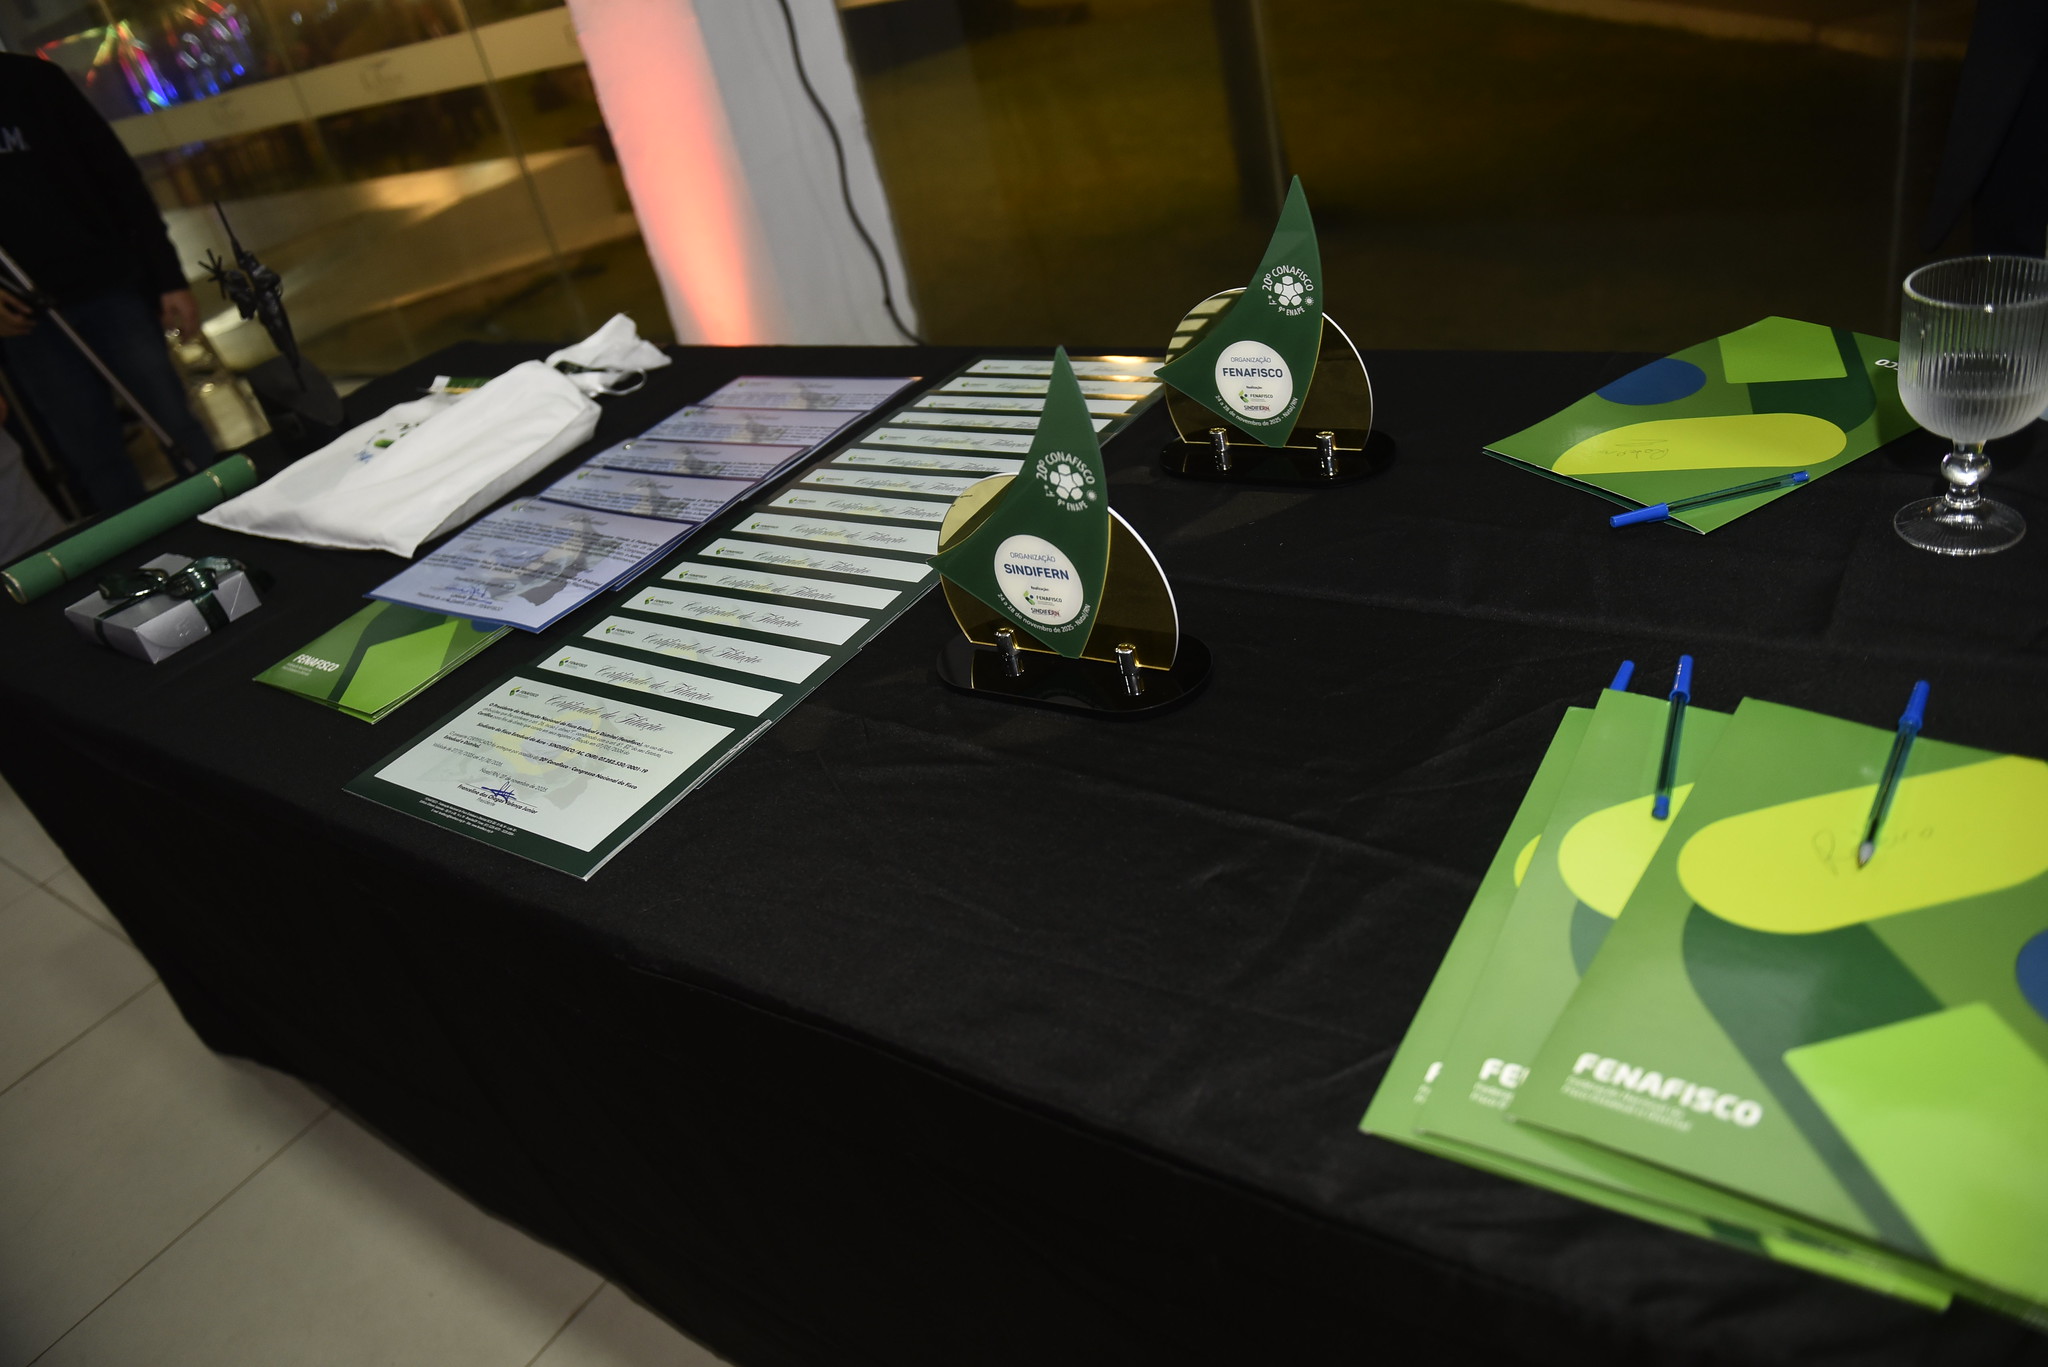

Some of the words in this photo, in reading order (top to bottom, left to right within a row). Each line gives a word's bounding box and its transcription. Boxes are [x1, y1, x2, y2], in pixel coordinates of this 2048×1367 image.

[1271, 265, 1314, 291] CONAFISCO
[1286, 306, 1305, 316] ENAPE
[1230, 356, 1271, 364] ORGANIZAÇÃO
[1222, 367, 1283, 378] FENAFISCO
[1235, 415, 1262, 426] novembro
[1282, 397, 1298, 418] Natal/RN
[1045, 451, 1095, 484] CONAFISCO
[1066, 500, 1088, 512] ENAPE
[790, 524, 846, 538] Certificado
[753, 552, 810, 567] Certificado
[1010, 552, 1056, 563] ORGANIZAÇÃO
[1004, 563, 1070, 580] SINDIFERN
[716, 576, 774, 592] Certificado
[770, 585, 790, 594] de
[1036, 595, 1062, 603] FENAFISCO
[681, 602, 740, 618] Certificado
[736, 612, 756, 620] de
[1014, 612, 1022, 620] de
[1022, 618, 1052, 633] novembro
[1061, 624, 1074, 632] 2025
[1075, 604, 1091, 626] Natal/RN
[1030, 608, 1060, 617] SINDIFERN
[642, 632, 700, 651] Certificado
[696, 645, 716, 655] de
[292, 653, 340, 672] FENAFISCO
[594, 664, 654, 689] Certificado
[648, 680, 669, 690] de
[519, 710, 542, 719] Federação
[541, 716, 561, 724] Nacional
[544, 694, 606, 716] Certificado
[599, 710, 620, 720] de
[614, 712, 666, 732] Filiação
[444, 734, 462, 742] Estadual
[477, 722, 497, 730] Sindicato
[511, 732, 531, 740] Estadual
[546, 760, 570, 769] Conafisco
[570, 767, 597, 777] Congresso
[595, 774, 619, 783] Nacional
[456, 784, 481, 795] Francelino
[487, 795, 506, 803] Chagas
[522, 806, 539, 814] Junior
[1572, 1052, 1764, 1128] FENAFISCO
